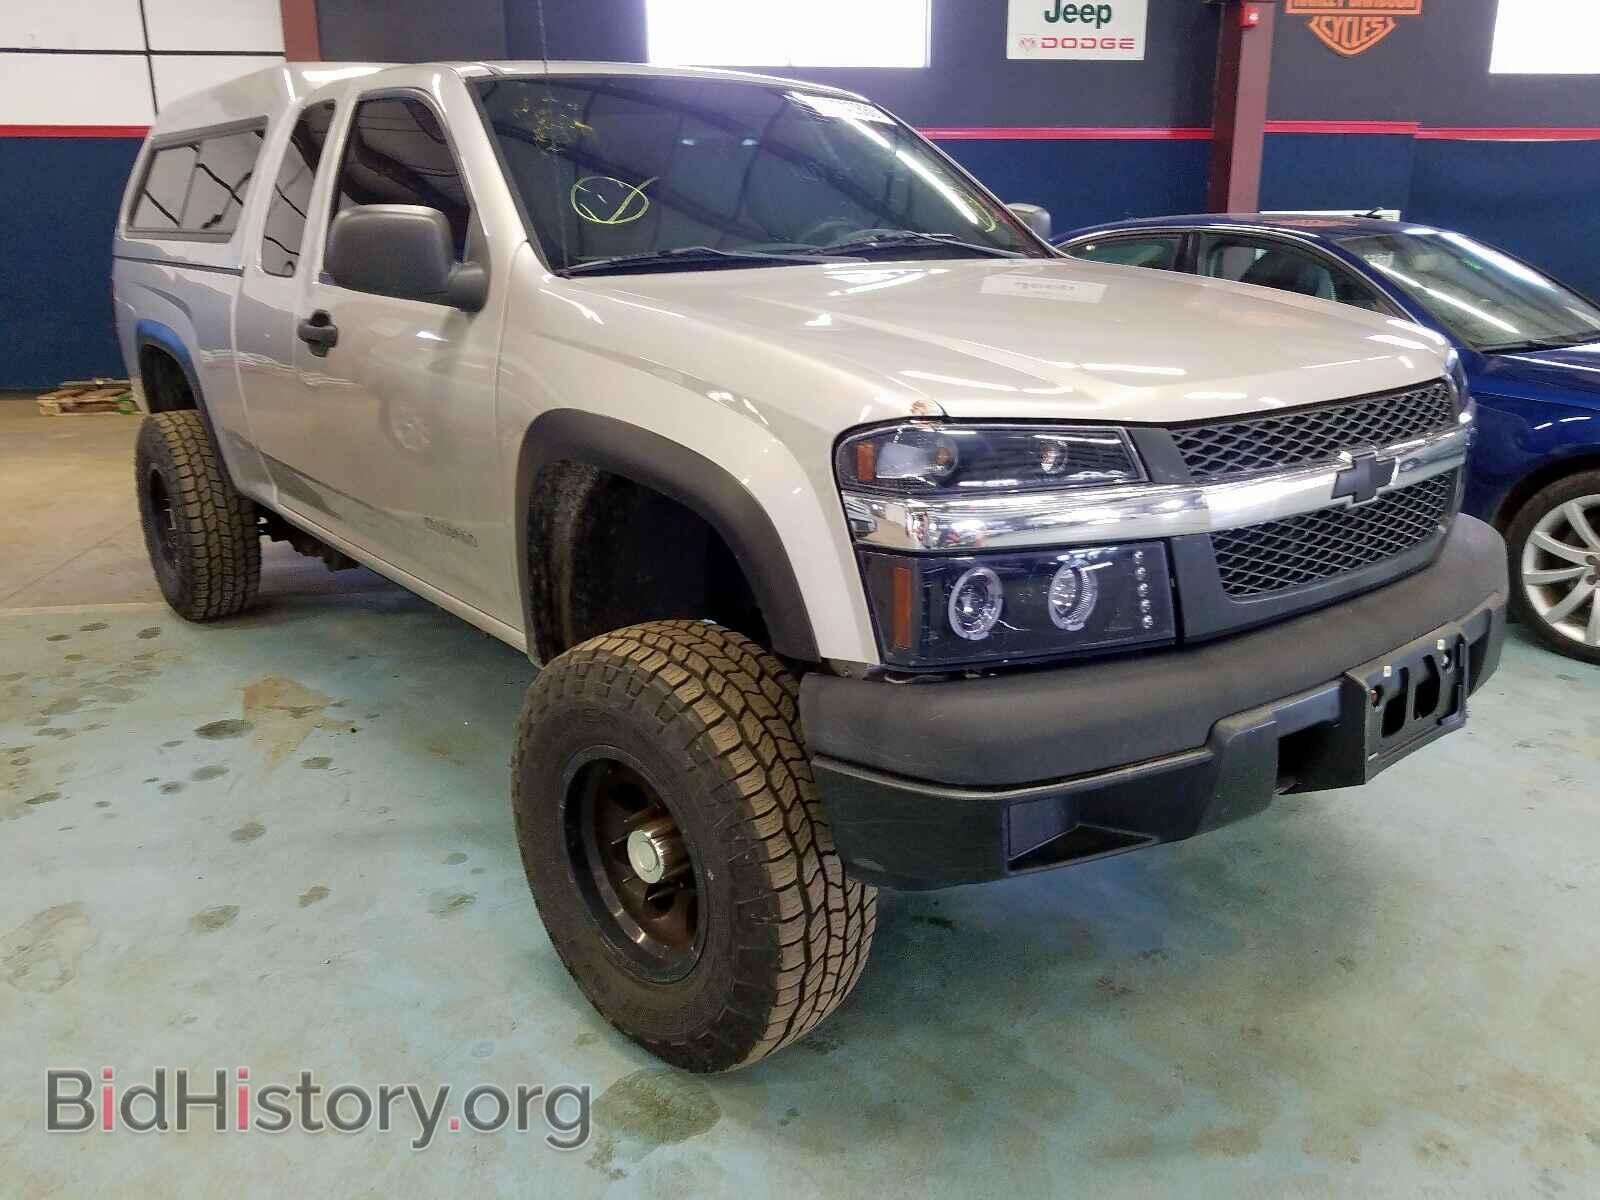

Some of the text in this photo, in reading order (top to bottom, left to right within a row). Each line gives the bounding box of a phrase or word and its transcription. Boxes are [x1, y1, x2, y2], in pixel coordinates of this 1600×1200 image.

[1044, 0, 1112, 30] Jeep
[1041, 37, 1135, 49] DODGE
[1319, 15, 1387, 47] CYCLES
